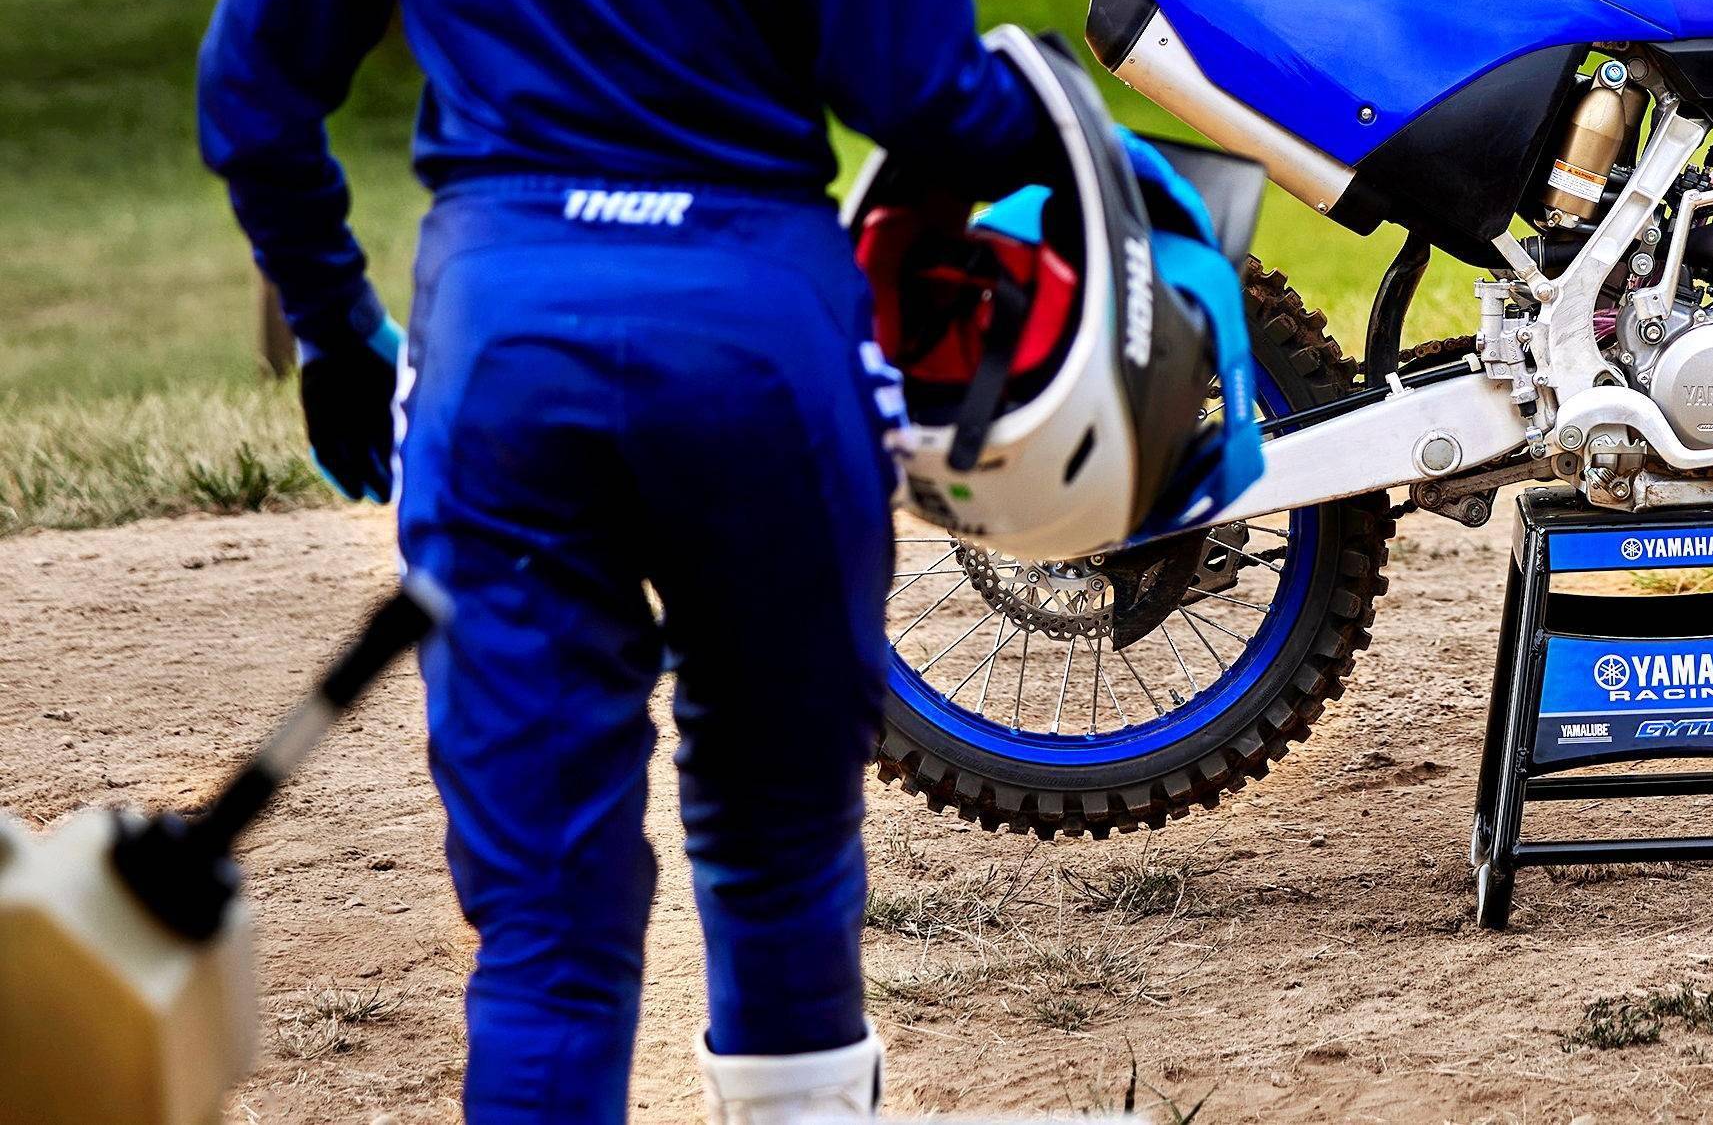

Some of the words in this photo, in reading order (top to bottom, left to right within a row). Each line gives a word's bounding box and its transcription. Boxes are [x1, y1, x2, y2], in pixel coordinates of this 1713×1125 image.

[563, 189, 694, 226] THOR
[1124, 236, 1153, 368] THOR
[1560, 723, 1609, 737] YAMALUBE
